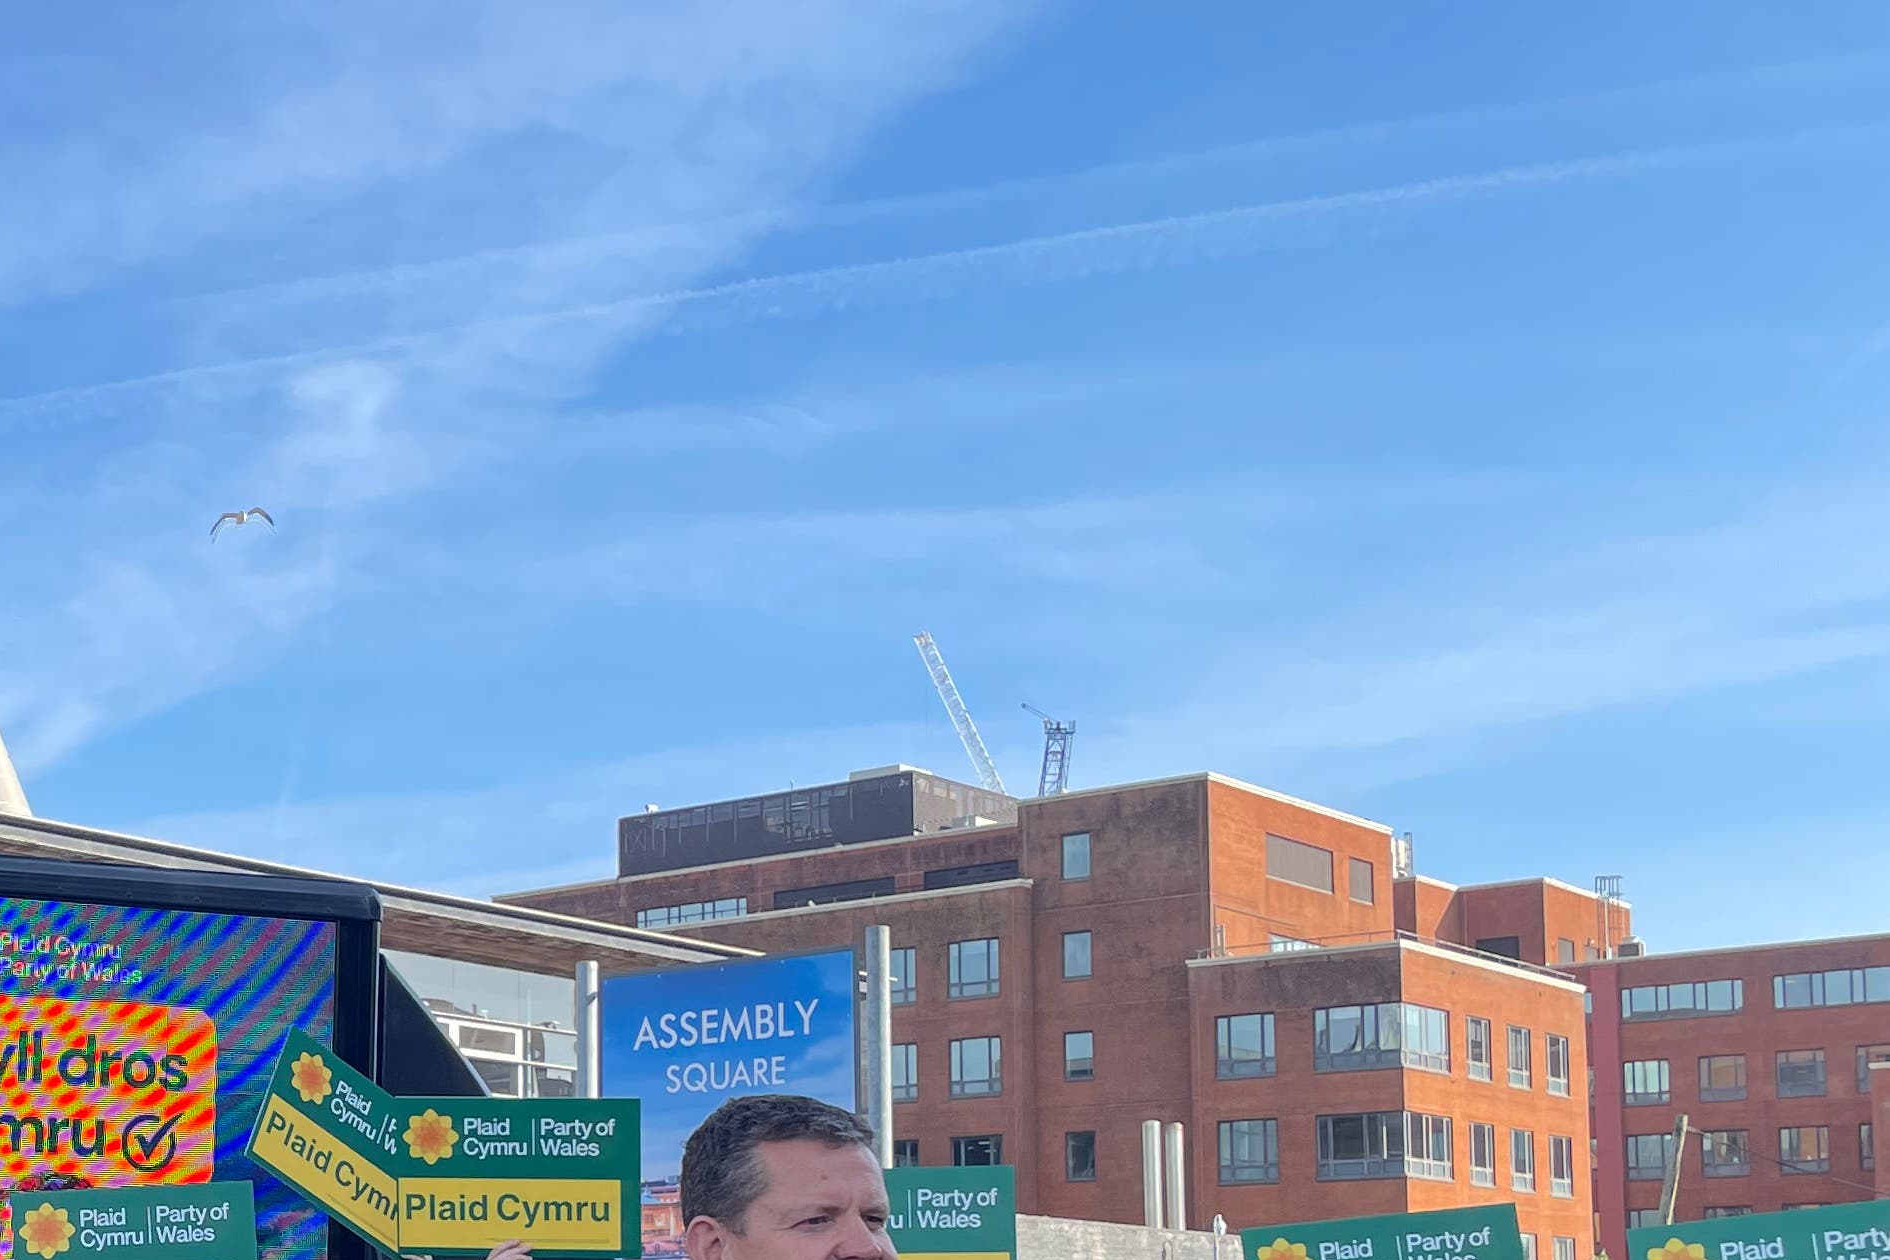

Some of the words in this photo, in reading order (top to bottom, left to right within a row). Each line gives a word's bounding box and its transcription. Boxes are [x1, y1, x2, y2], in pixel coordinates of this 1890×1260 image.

[632, 998, 819, 1051] ASSEMBLY
[58, 1034, 189, 1092] dros
[666, 1055, 786, 1094] SQUARE
[335, 1080, 372, 1116] Plaid
[330, 1097, 377, 1141] Cymru
[463, 1117, 510, 1136] Plaid
[540, 1118, 594, 1141] Party
[595, 1118, 616, 1136] of
[463, 1137, 527, 1160] Cymru
[540, 1138, 600, 1157] Wales
[266, 1110, 333, 1174] Plaid
[334, 1160, 398, 1222] Cym
[406, 1193, 488, 1221] Plaid
[497, 1193, 610, 1229] Cymru
[917, 1188, 974, 1211] Party
[976, 1187, 998, 1207] of
[79, 1207, 126, 1228] Plaid
[155, 1205, 208, 1226] Party
[210, 1202, 230, 1220] of
[916, 1209, 982, 1229] Wales
[80, 1229, 144, 1252] Cymru
[156, 1224, 215, 1244] Wales
[1406, 1232, 1466, 1253] Party
[1468, 1226, 1491, 1247] of
[1319, 1239, 1373, 1260] Plaid
